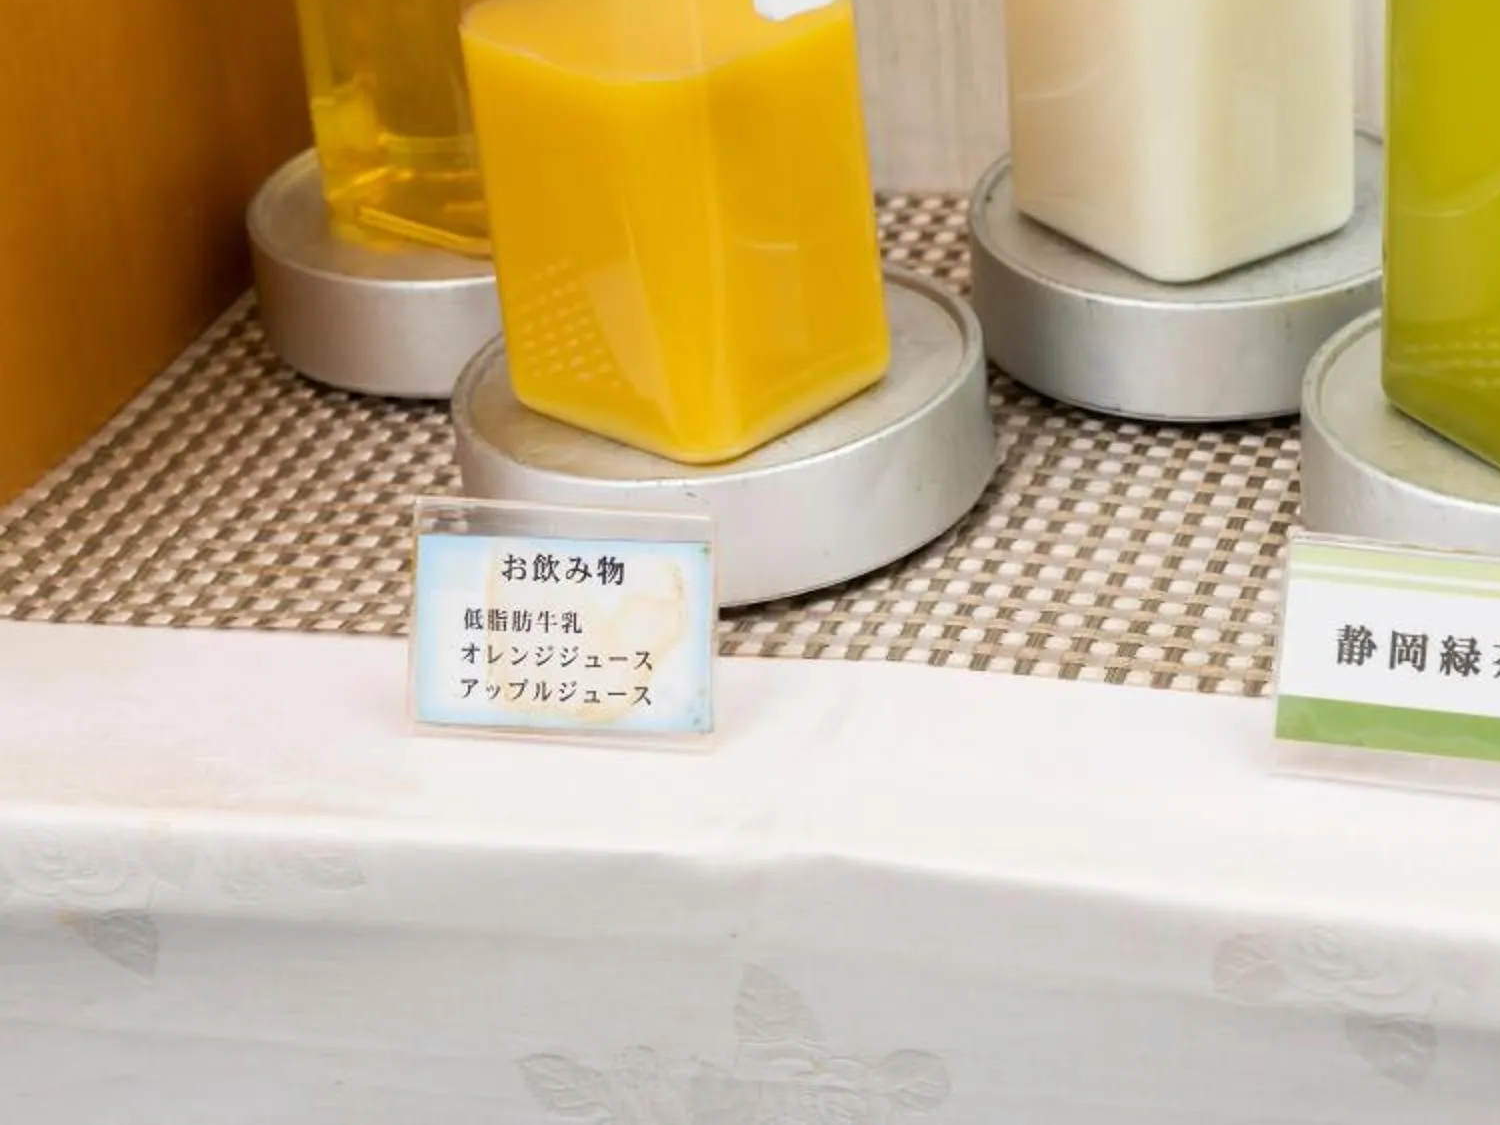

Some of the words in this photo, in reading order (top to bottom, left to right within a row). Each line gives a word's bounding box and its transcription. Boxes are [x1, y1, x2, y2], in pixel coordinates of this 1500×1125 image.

[502, 553, 625, 586] お飲み物
[463, 608, 583, 633] 低脂肪牛乳
[461, 642, 653, 671] オレンジジュース
[460, 678, 652, 705] アップルジュース
